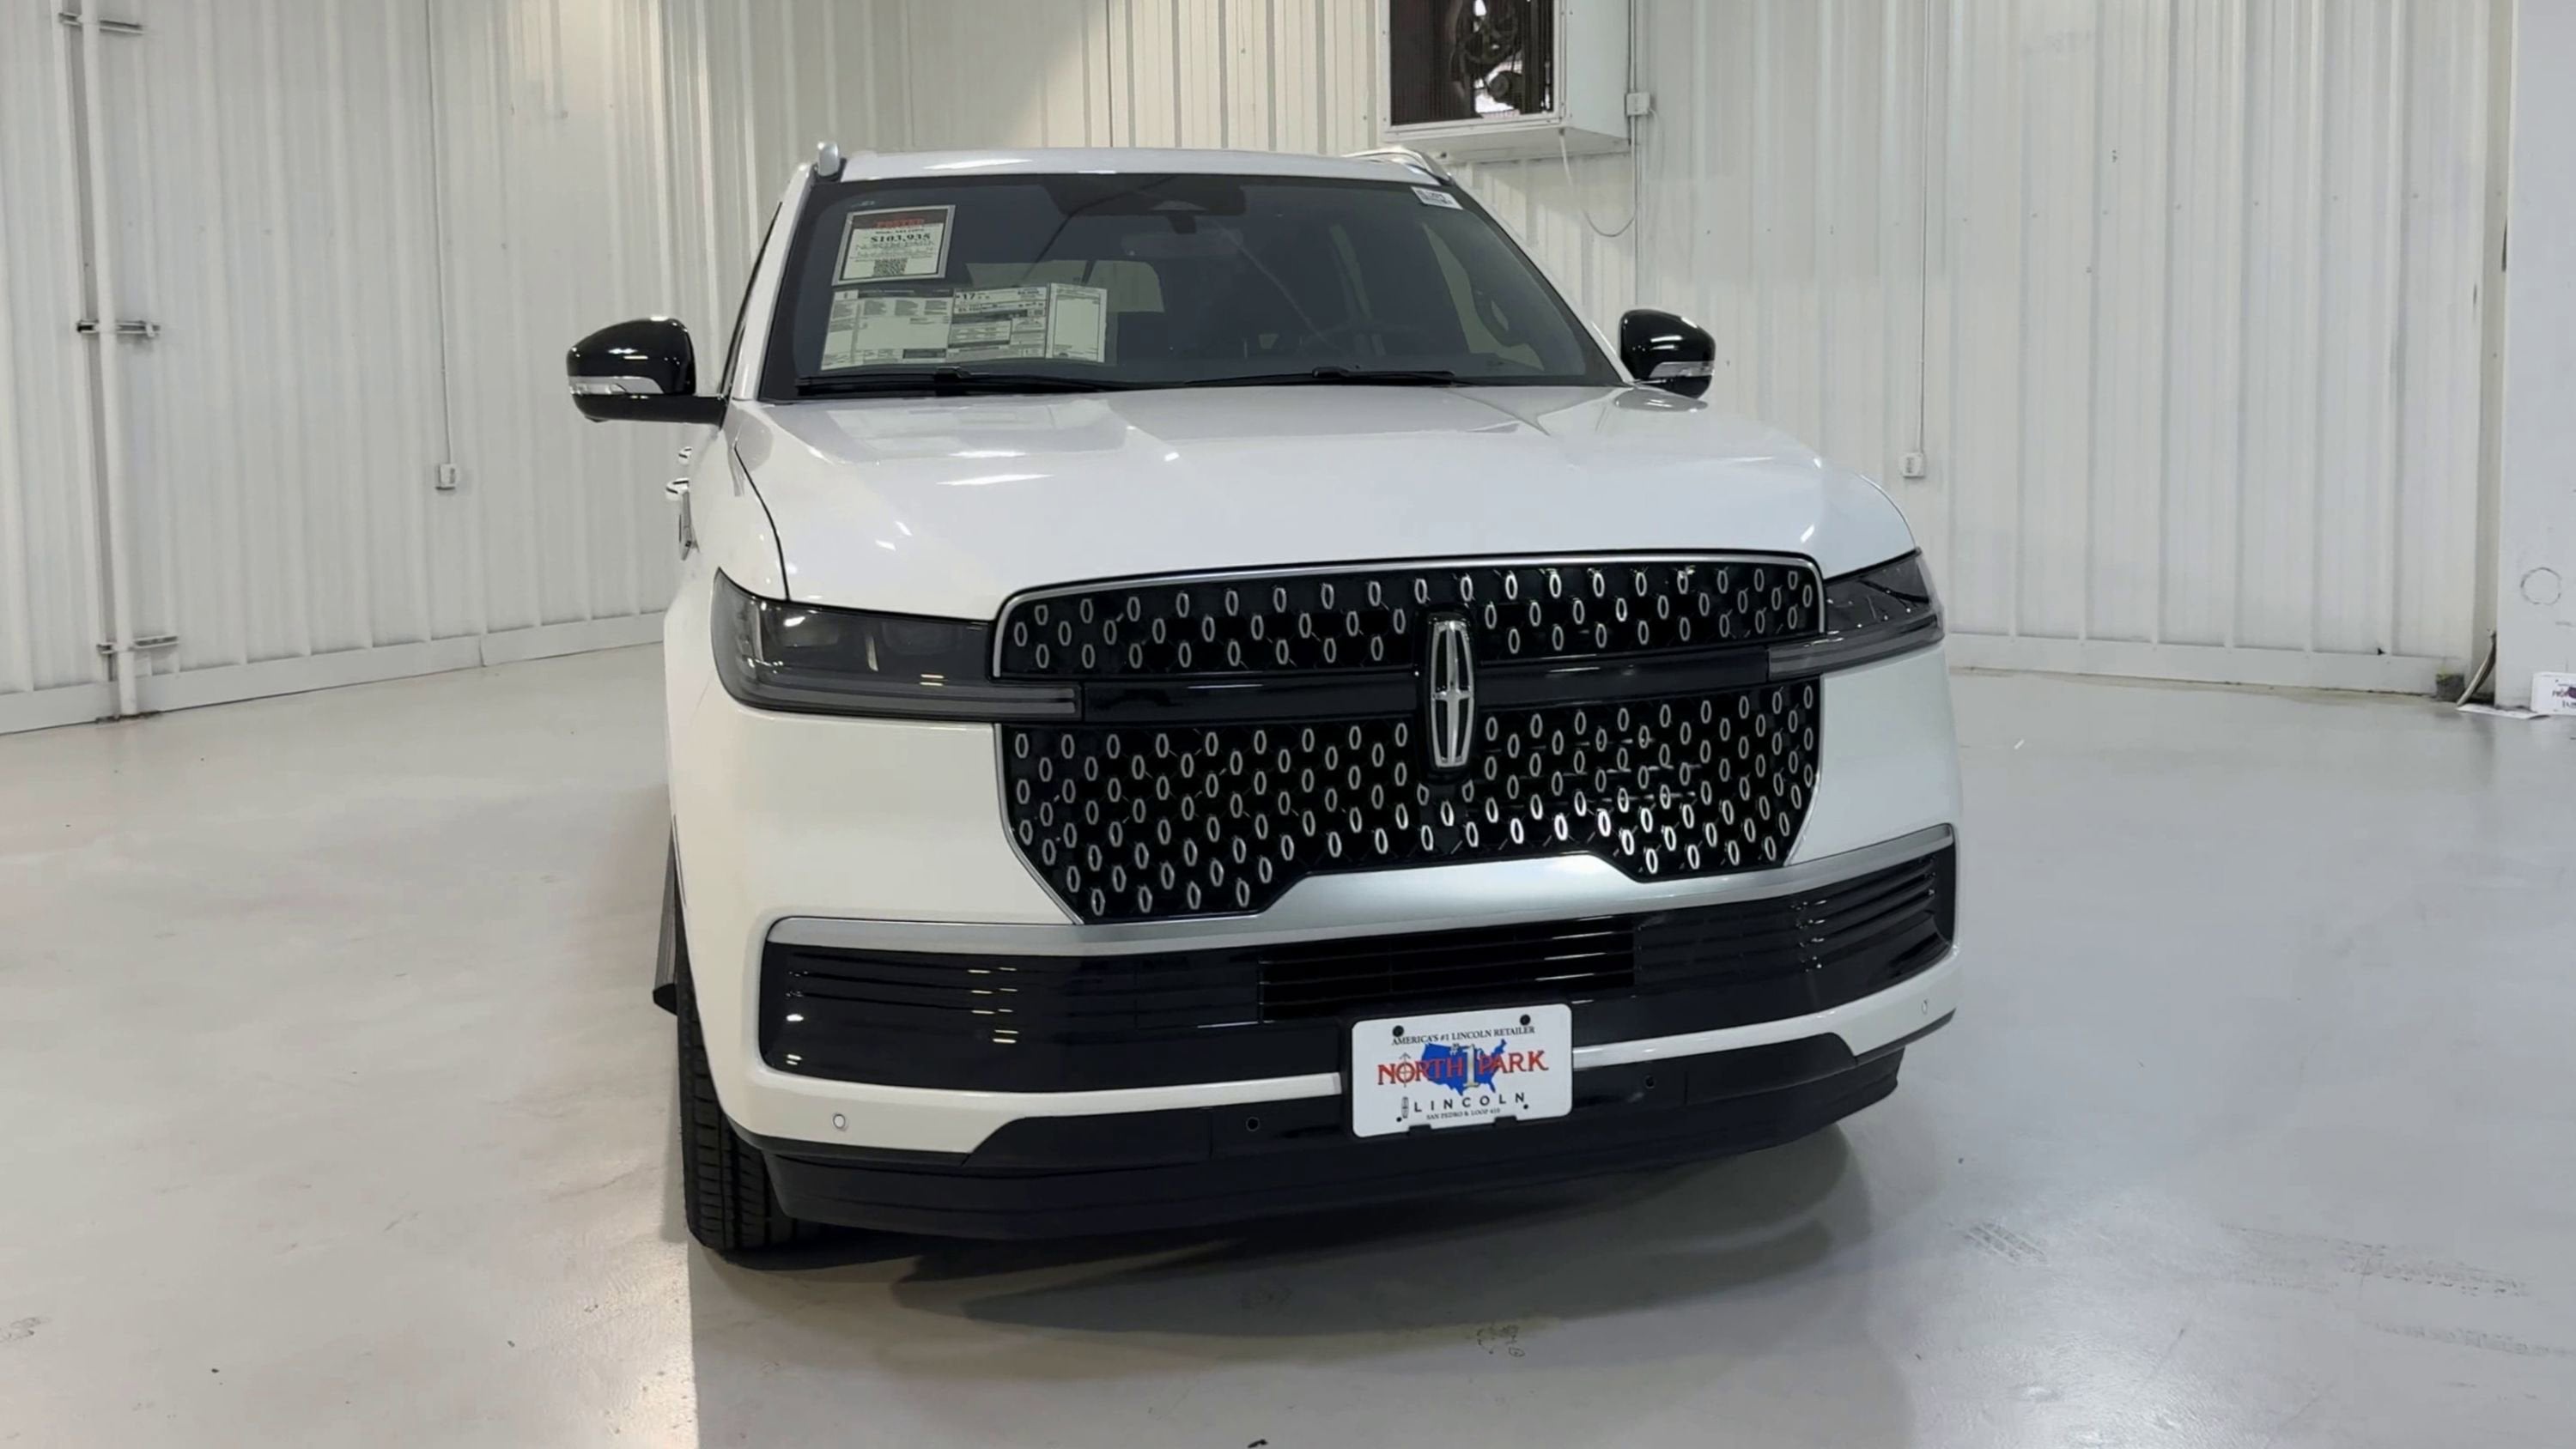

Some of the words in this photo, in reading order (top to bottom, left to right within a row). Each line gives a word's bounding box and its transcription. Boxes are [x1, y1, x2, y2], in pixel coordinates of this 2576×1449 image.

[1392, 1034, 1439, 1046] AMERICA'S
[1440, 1033, 1449, 1041] #1
[1451, 1029, 1492, 1040] LINCOLN
[1493, 1026, 1535, 1037] RETAILER
[1377, 1057, 1464, 1086] NORTH
[1479, 1050, 1549, 1075] PARK
[1414, 1092, 1525, 1113] LINCOLN
